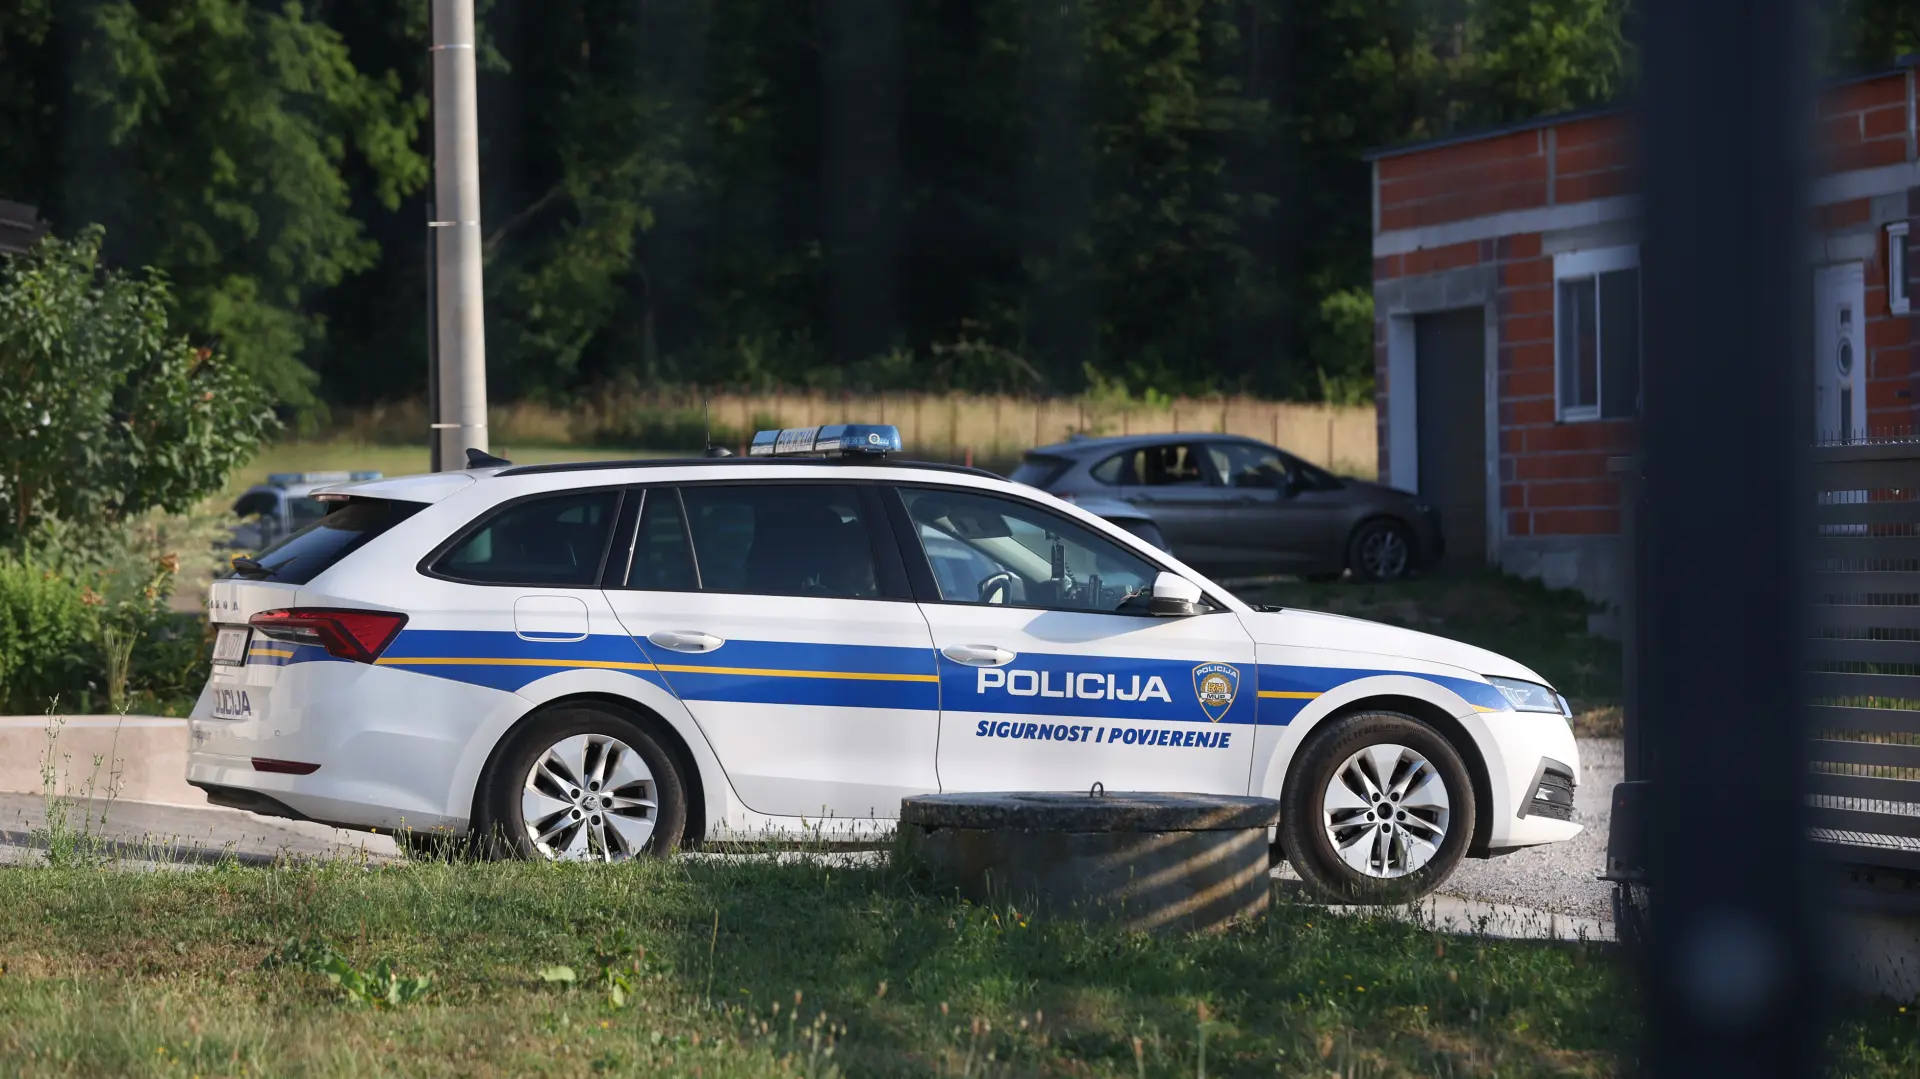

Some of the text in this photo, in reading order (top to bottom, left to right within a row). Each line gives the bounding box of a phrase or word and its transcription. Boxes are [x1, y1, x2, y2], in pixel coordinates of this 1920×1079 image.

[1196, 665, 1237, 678] POLICIJA
[976, 667, 1172, 703] POLICIJA
[1208, 682, 1224, 693] RH
[975, 719, 1231, 749] SIGURNOST I POVJERENJE
